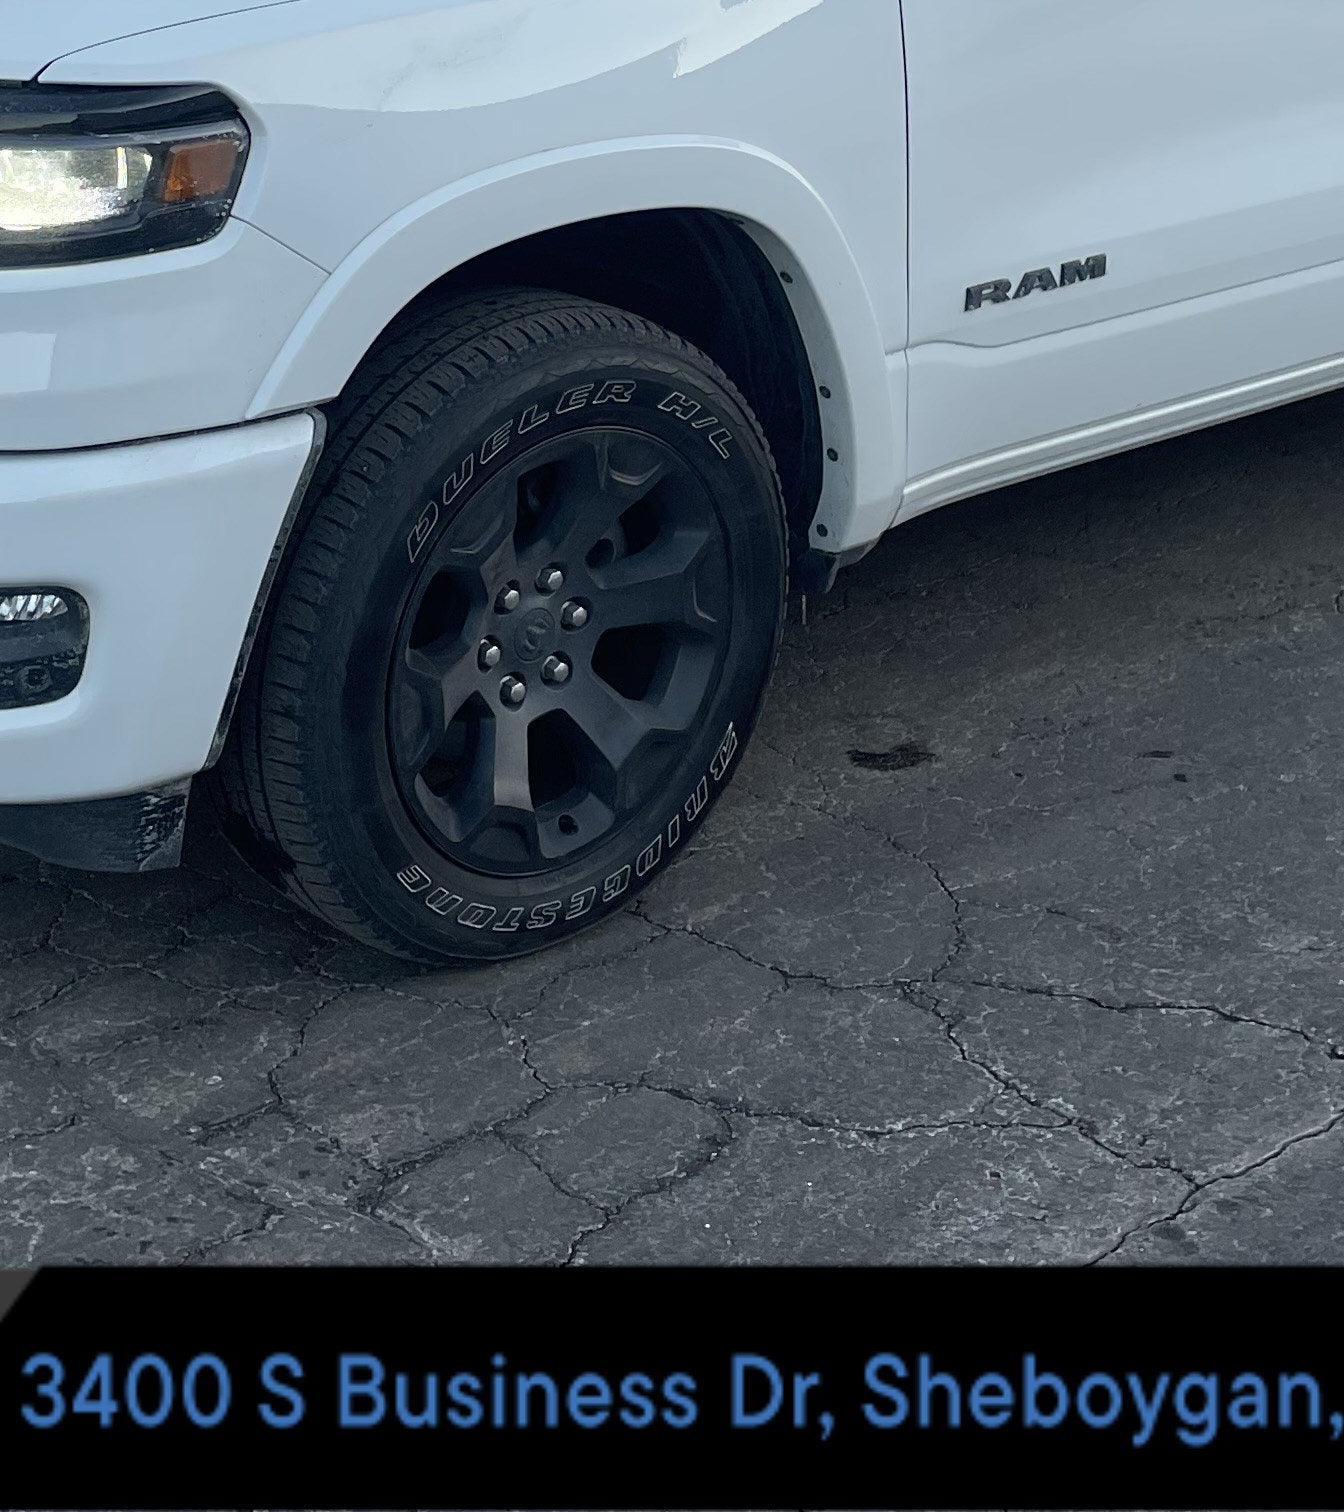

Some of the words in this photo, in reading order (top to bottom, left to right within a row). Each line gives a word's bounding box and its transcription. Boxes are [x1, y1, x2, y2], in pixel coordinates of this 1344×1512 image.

[963, 252, 1108, 313] RAM
[406, 379, 637, 564] DUELER
[656, 391, 733, 460] H/L
[396, 720, 739, 932] BRIDGESTONE
